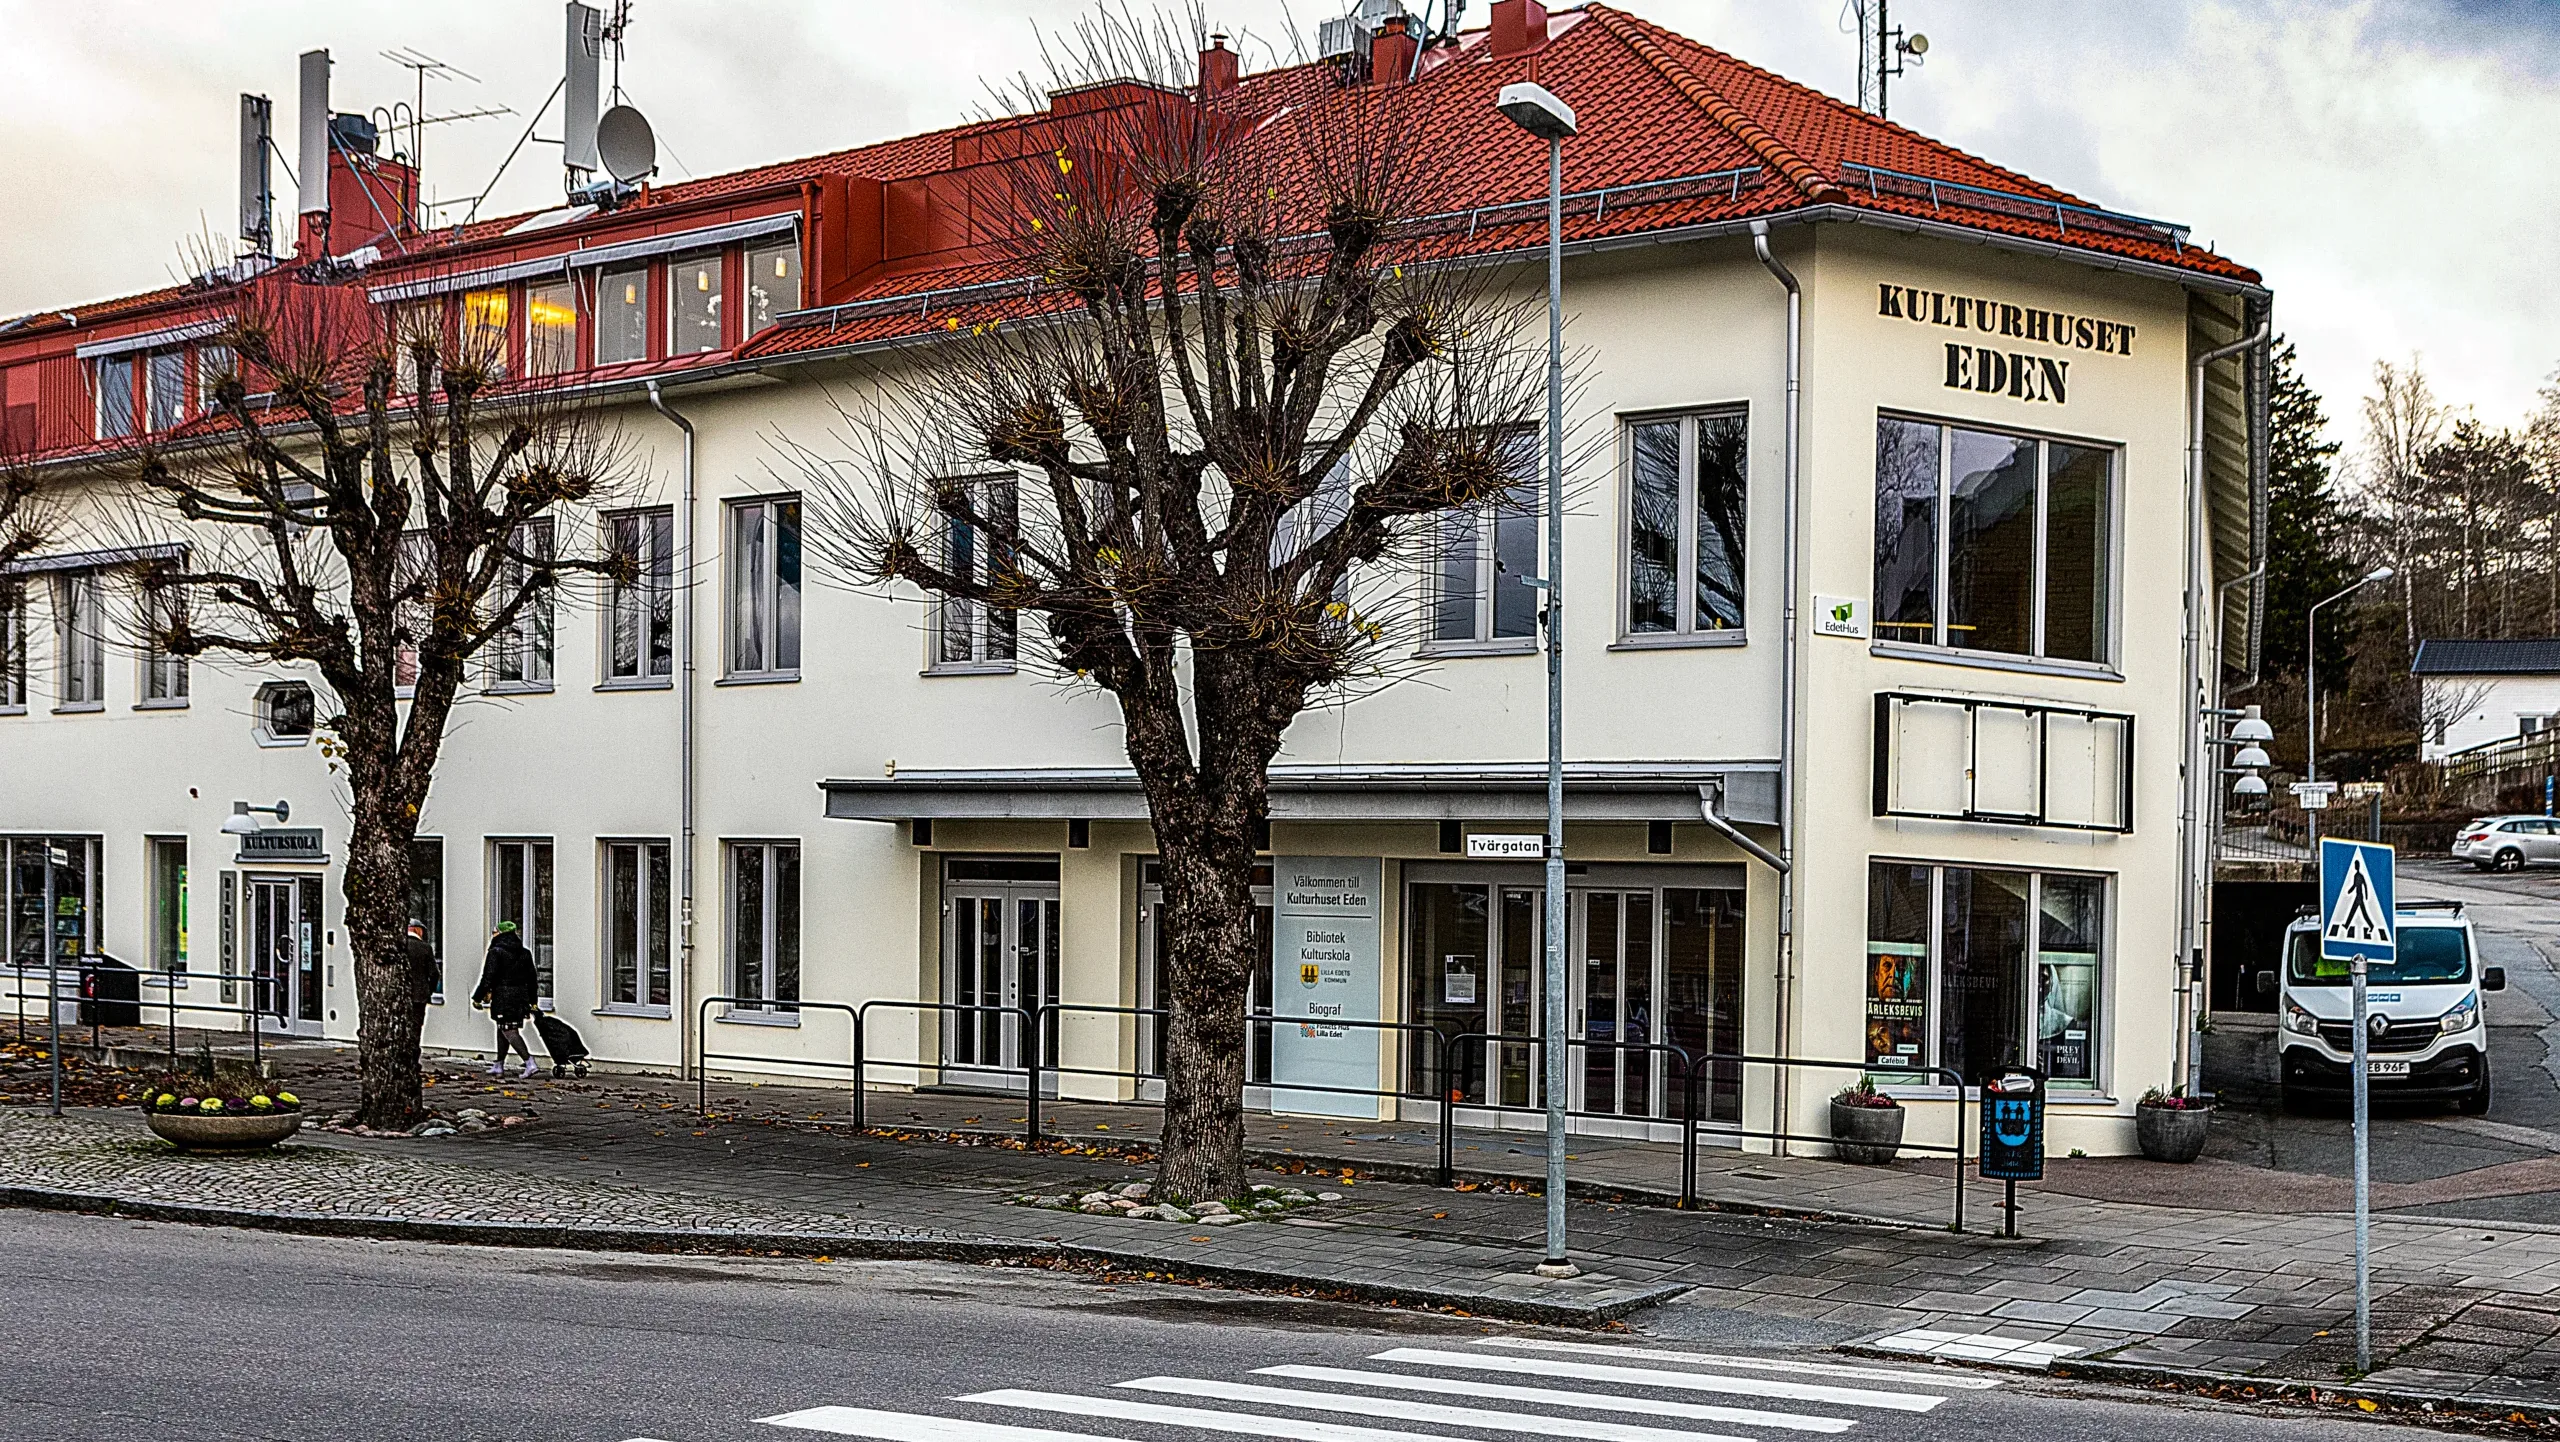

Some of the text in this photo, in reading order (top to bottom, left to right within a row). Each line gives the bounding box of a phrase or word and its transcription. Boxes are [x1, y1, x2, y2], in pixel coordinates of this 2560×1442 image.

[1878, 283, 2136, 357] KULTURHUSET
[1944, 343, 2070, 404] EDEN
[1825, 621, 1859, 634] EdetHus
[244, 836, 318, 850] KULTURSKOLA
[1470, 839, 1540, 854] Tvärgatan
[1293, 875, 1360, 889] Välkommen till
[1287, 891, 1367, 906] Kulturhuset Eden
[1306, 930, 1346, 944] Bibliotek
[1301, 947, 1351, 961] Kulturskola
[1335, 969, 1351, 977] EDETS
[1309, 1002, 1342, 1018] Biograf
[1867, 1001, 1923, 1017] ÄRLEKSBEVIS
[1329, 1030, 1343, 1038] Edet
[2056, 1045, 2080, 1054] PREY
[2056, 1056, 2080, 1064] DEVIL
[2367, 1063, 2405, 1073] EB 96F
